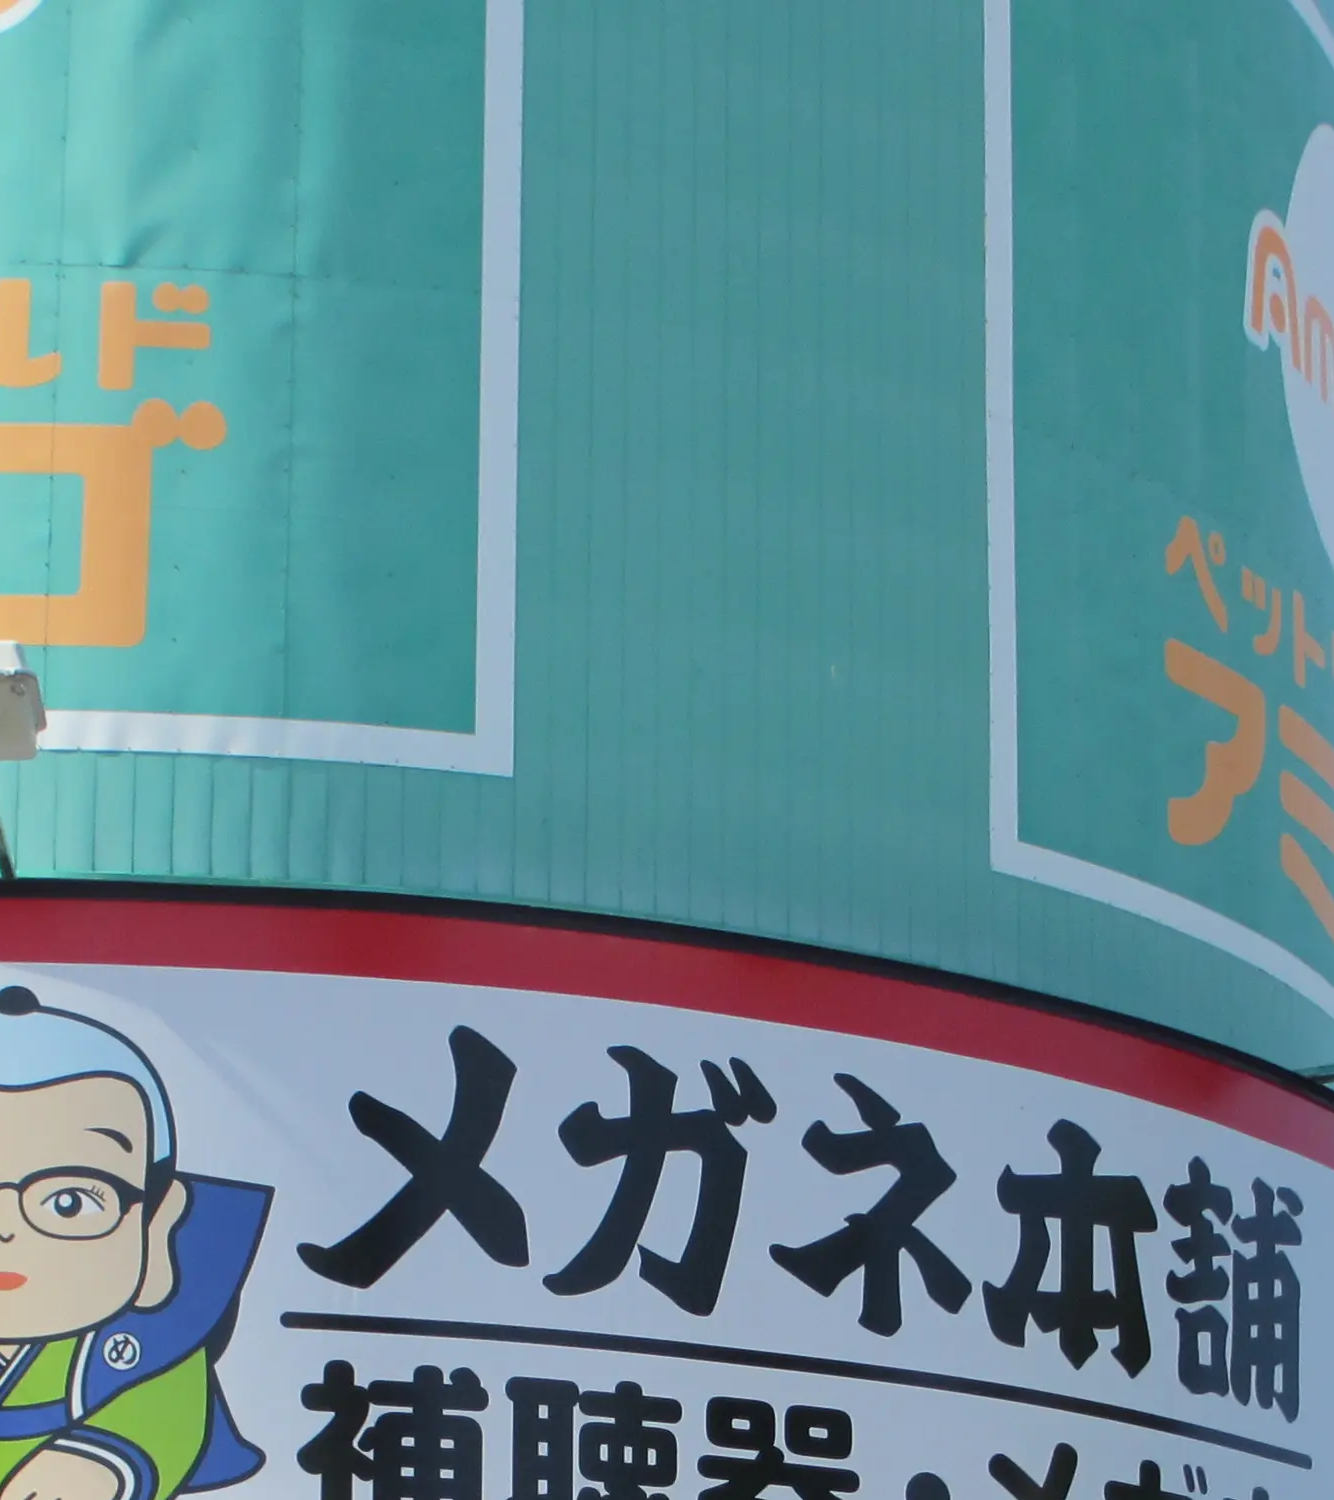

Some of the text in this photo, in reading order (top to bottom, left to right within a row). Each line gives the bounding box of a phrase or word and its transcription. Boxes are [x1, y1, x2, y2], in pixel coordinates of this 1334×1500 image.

[295, 1024, 1302, 1424] メガネ本舗
